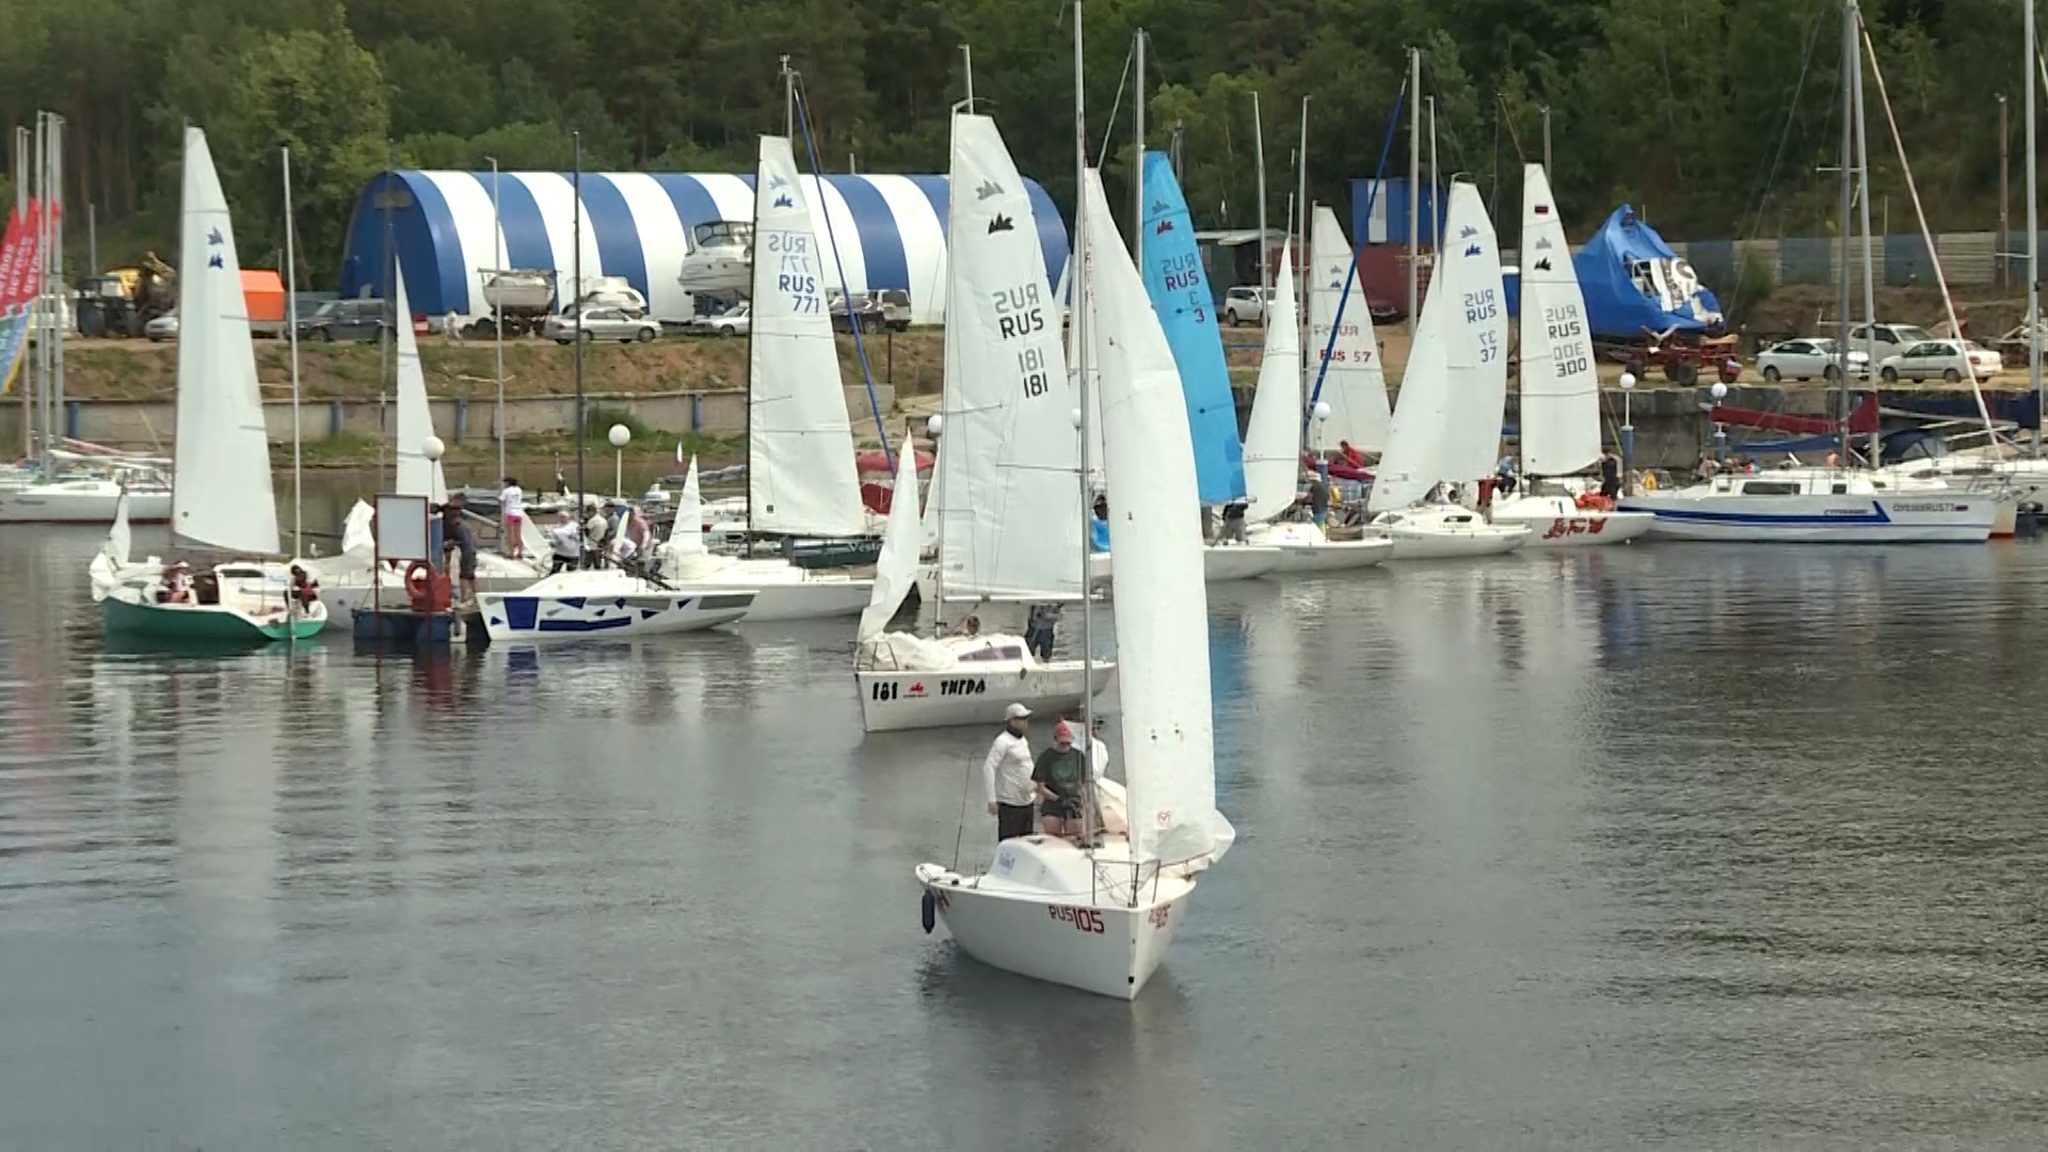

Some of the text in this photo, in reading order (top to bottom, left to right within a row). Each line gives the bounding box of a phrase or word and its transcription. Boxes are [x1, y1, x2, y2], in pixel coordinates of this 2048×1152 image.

[779, 273, 816, 294] RUS
[1165, 270, 1200, 292] RUS
[792, 294, 819, 314] 771
[1467, 304, 1497, 323] RUS
[999, 308, 1044, 339] RUS
[1193, 308, 1205, 323] 3
[1548, 321, 1580, 339] RUS
[1353, 351, 1372, 362] 57
[1480, 346, 1498, 363] 37
[1555, 357, 1587, 378] 300
[1023, 371, 1048, 399] 181
[872, 681, 899, 701] 181
